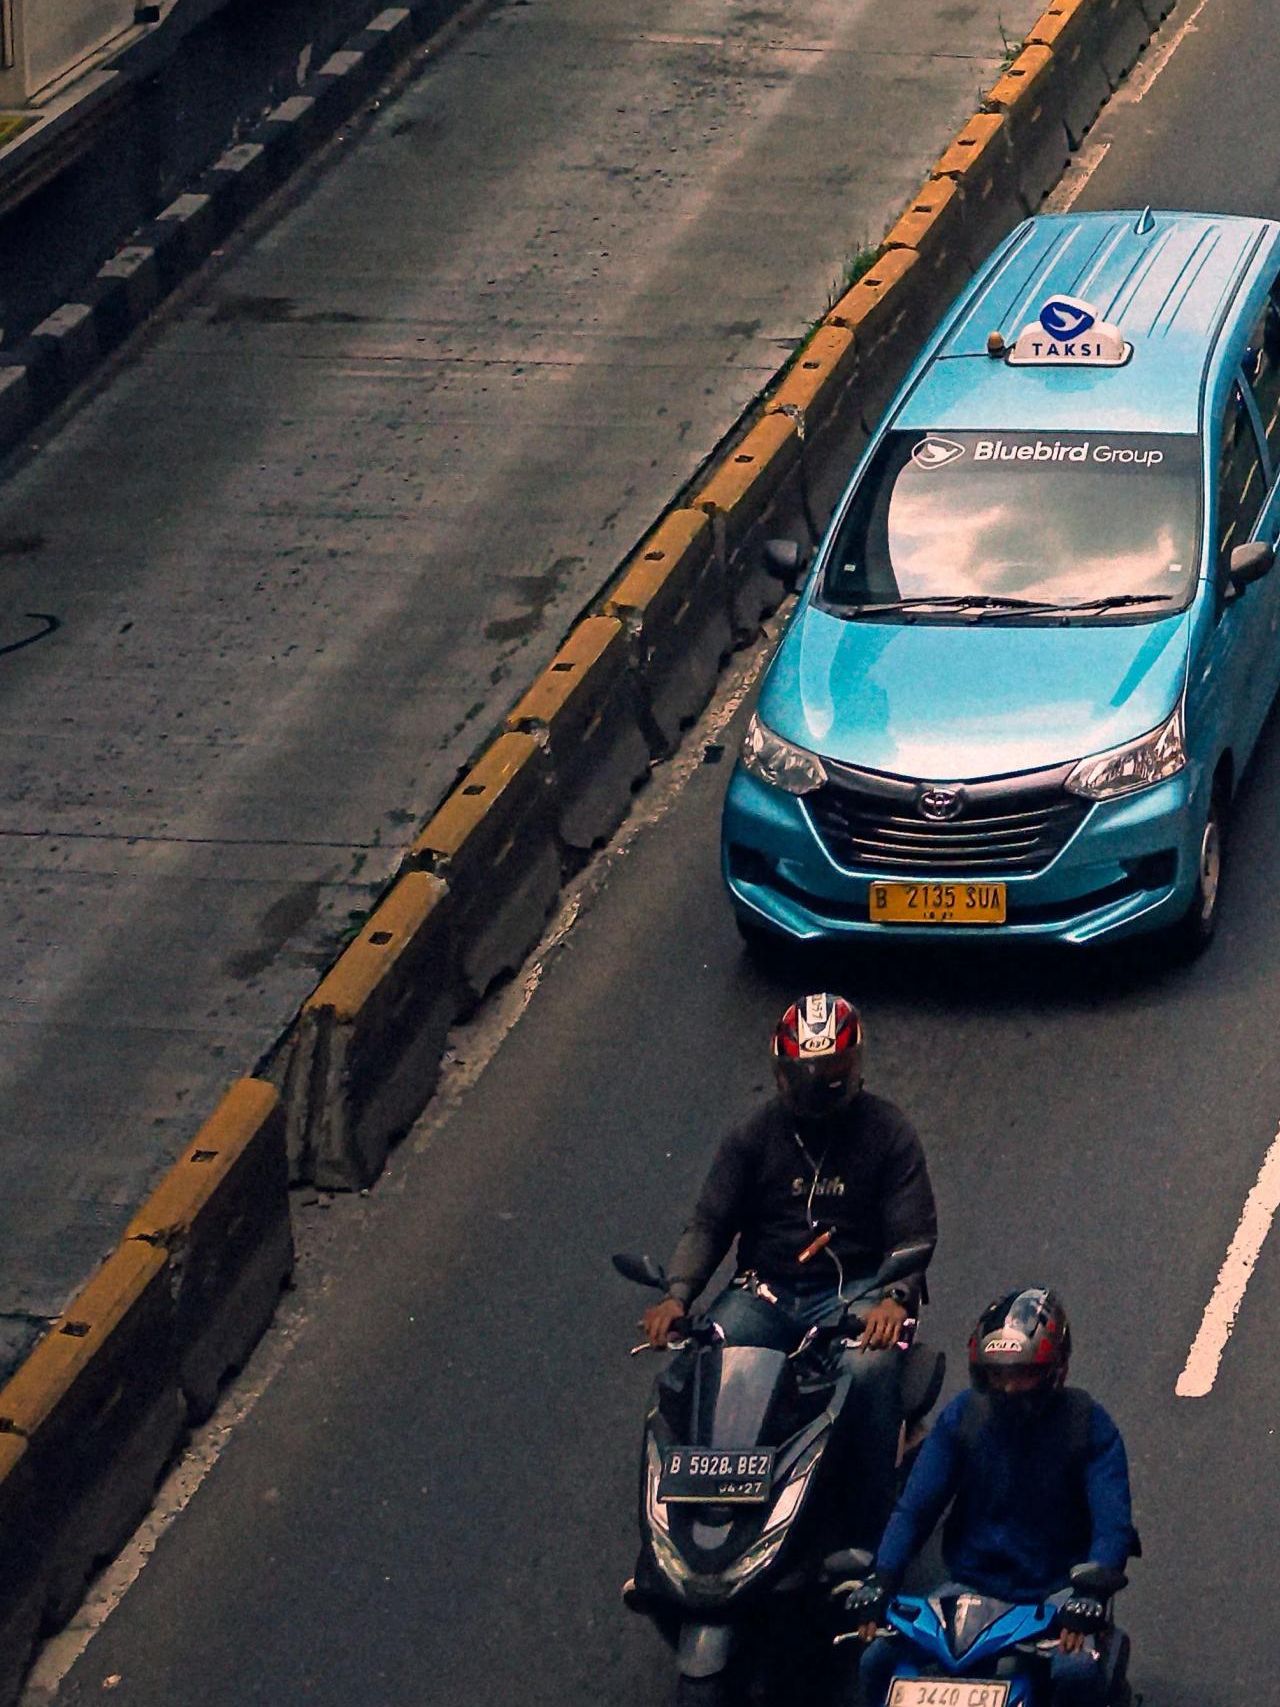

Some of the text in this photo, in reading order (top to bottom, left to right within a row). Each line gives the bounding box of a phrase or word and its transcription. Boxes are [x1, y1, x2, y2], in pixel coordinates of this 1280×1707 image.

[1032, 343, 1101, 356] TAKSI
[974, 440, 1164, 467] Bluebird Group
[876, 887, 1000, 908] B 2135 SUA
[670, 1456, 768, 1475] B 5928 BEZ
